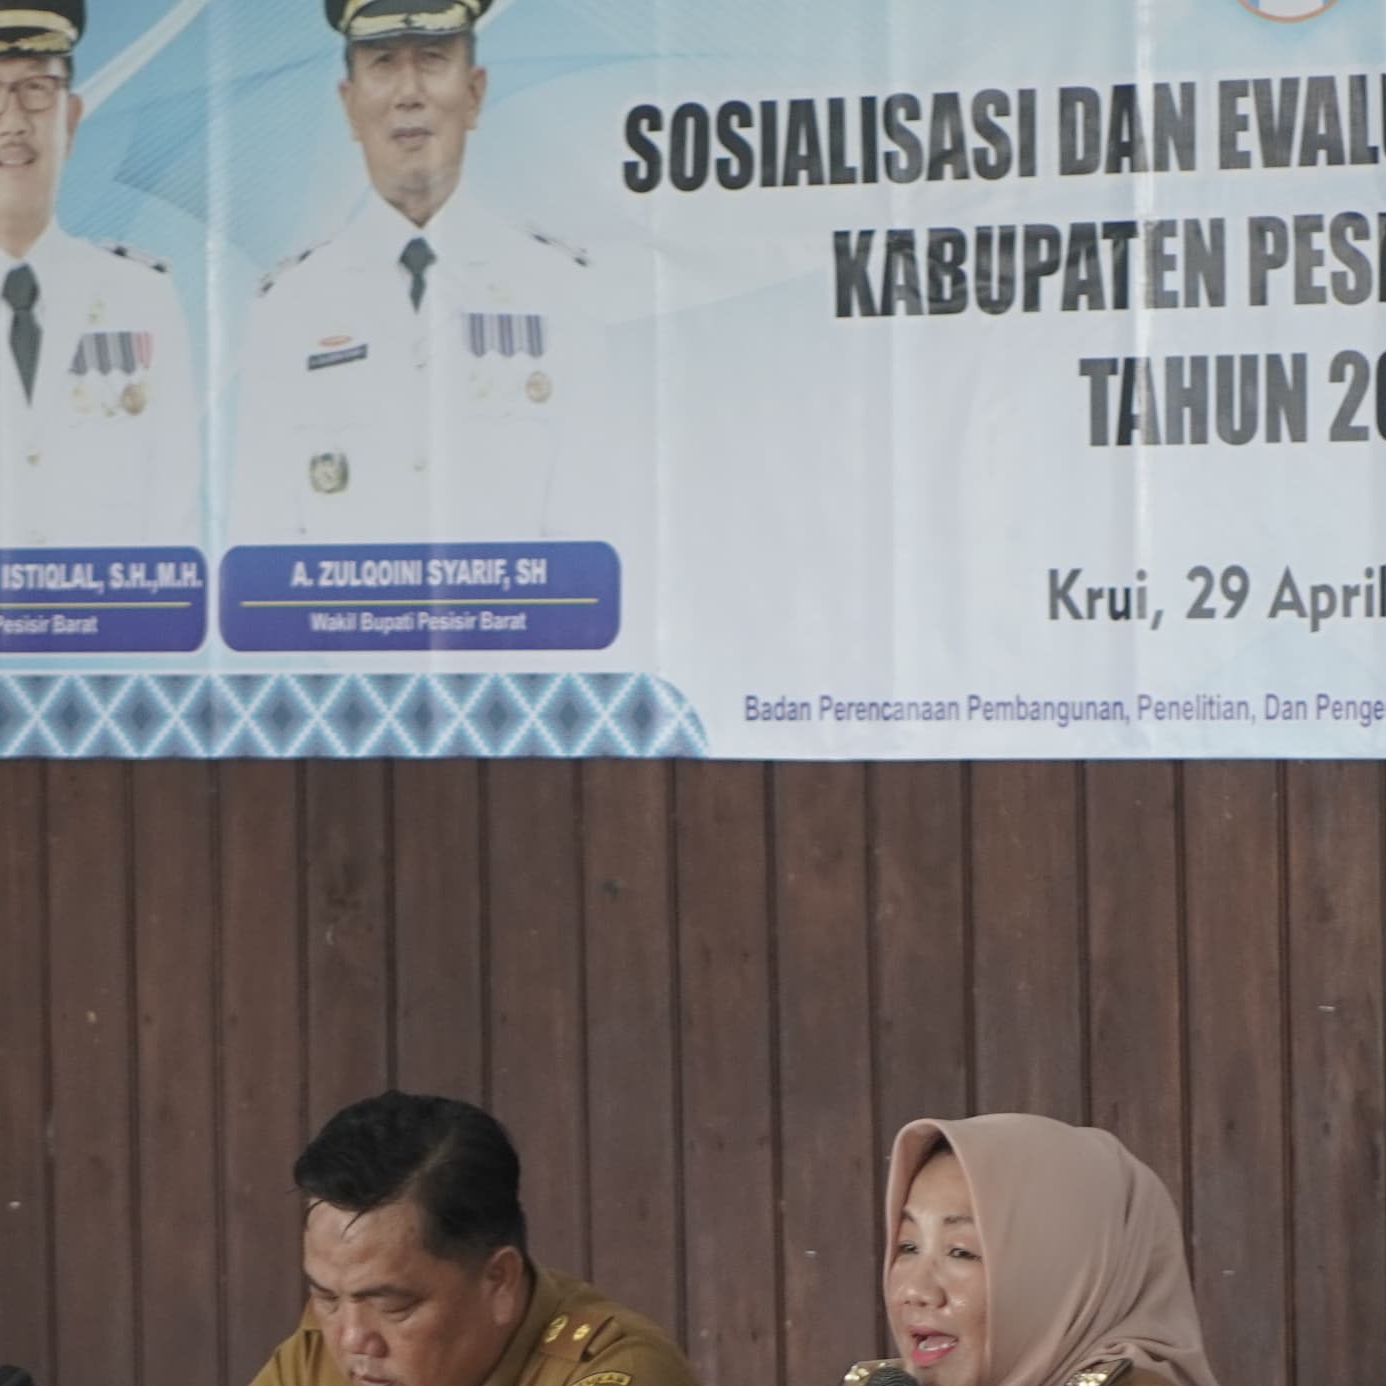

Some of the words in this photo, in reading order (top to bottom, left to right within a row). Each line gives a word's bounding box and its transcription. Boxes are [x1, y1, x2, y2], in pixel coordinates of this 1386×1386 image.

[623, 89, 1037, 193] SOSIALISASI
[1059, 81, 1196, 176] DAN
[833, 217, 1226, 318] KABUPATEN
[1079, 352, 1308, 447] TAHUN
[1, 562, 105, 595] ISTIQLAL,
[289, 562, 313, 588] A.
[427, 558, 511, 591] SYARIF,
[516, 558, 548, 584] SH
[1047, 568, 1164, 630] Krui,
[1185, 565, 1251, 620] 29
[52, 611, 99, 633] Barat
[309, 614, 356, 633] Wakil
[360, 612, 414, 635] Bupati
[417, 610, 475, 631] Pesisir
[479, 609, 527, 630] Barat
[744, 695, 812, 723] Badan
[818, 695, 961, 723] Perencanaan
[967, 695, 1130, 728] Pembangunan,
[1137, 694, 1256, 726] Penelitian,
[1264, 694, 1308, 721] Dan
